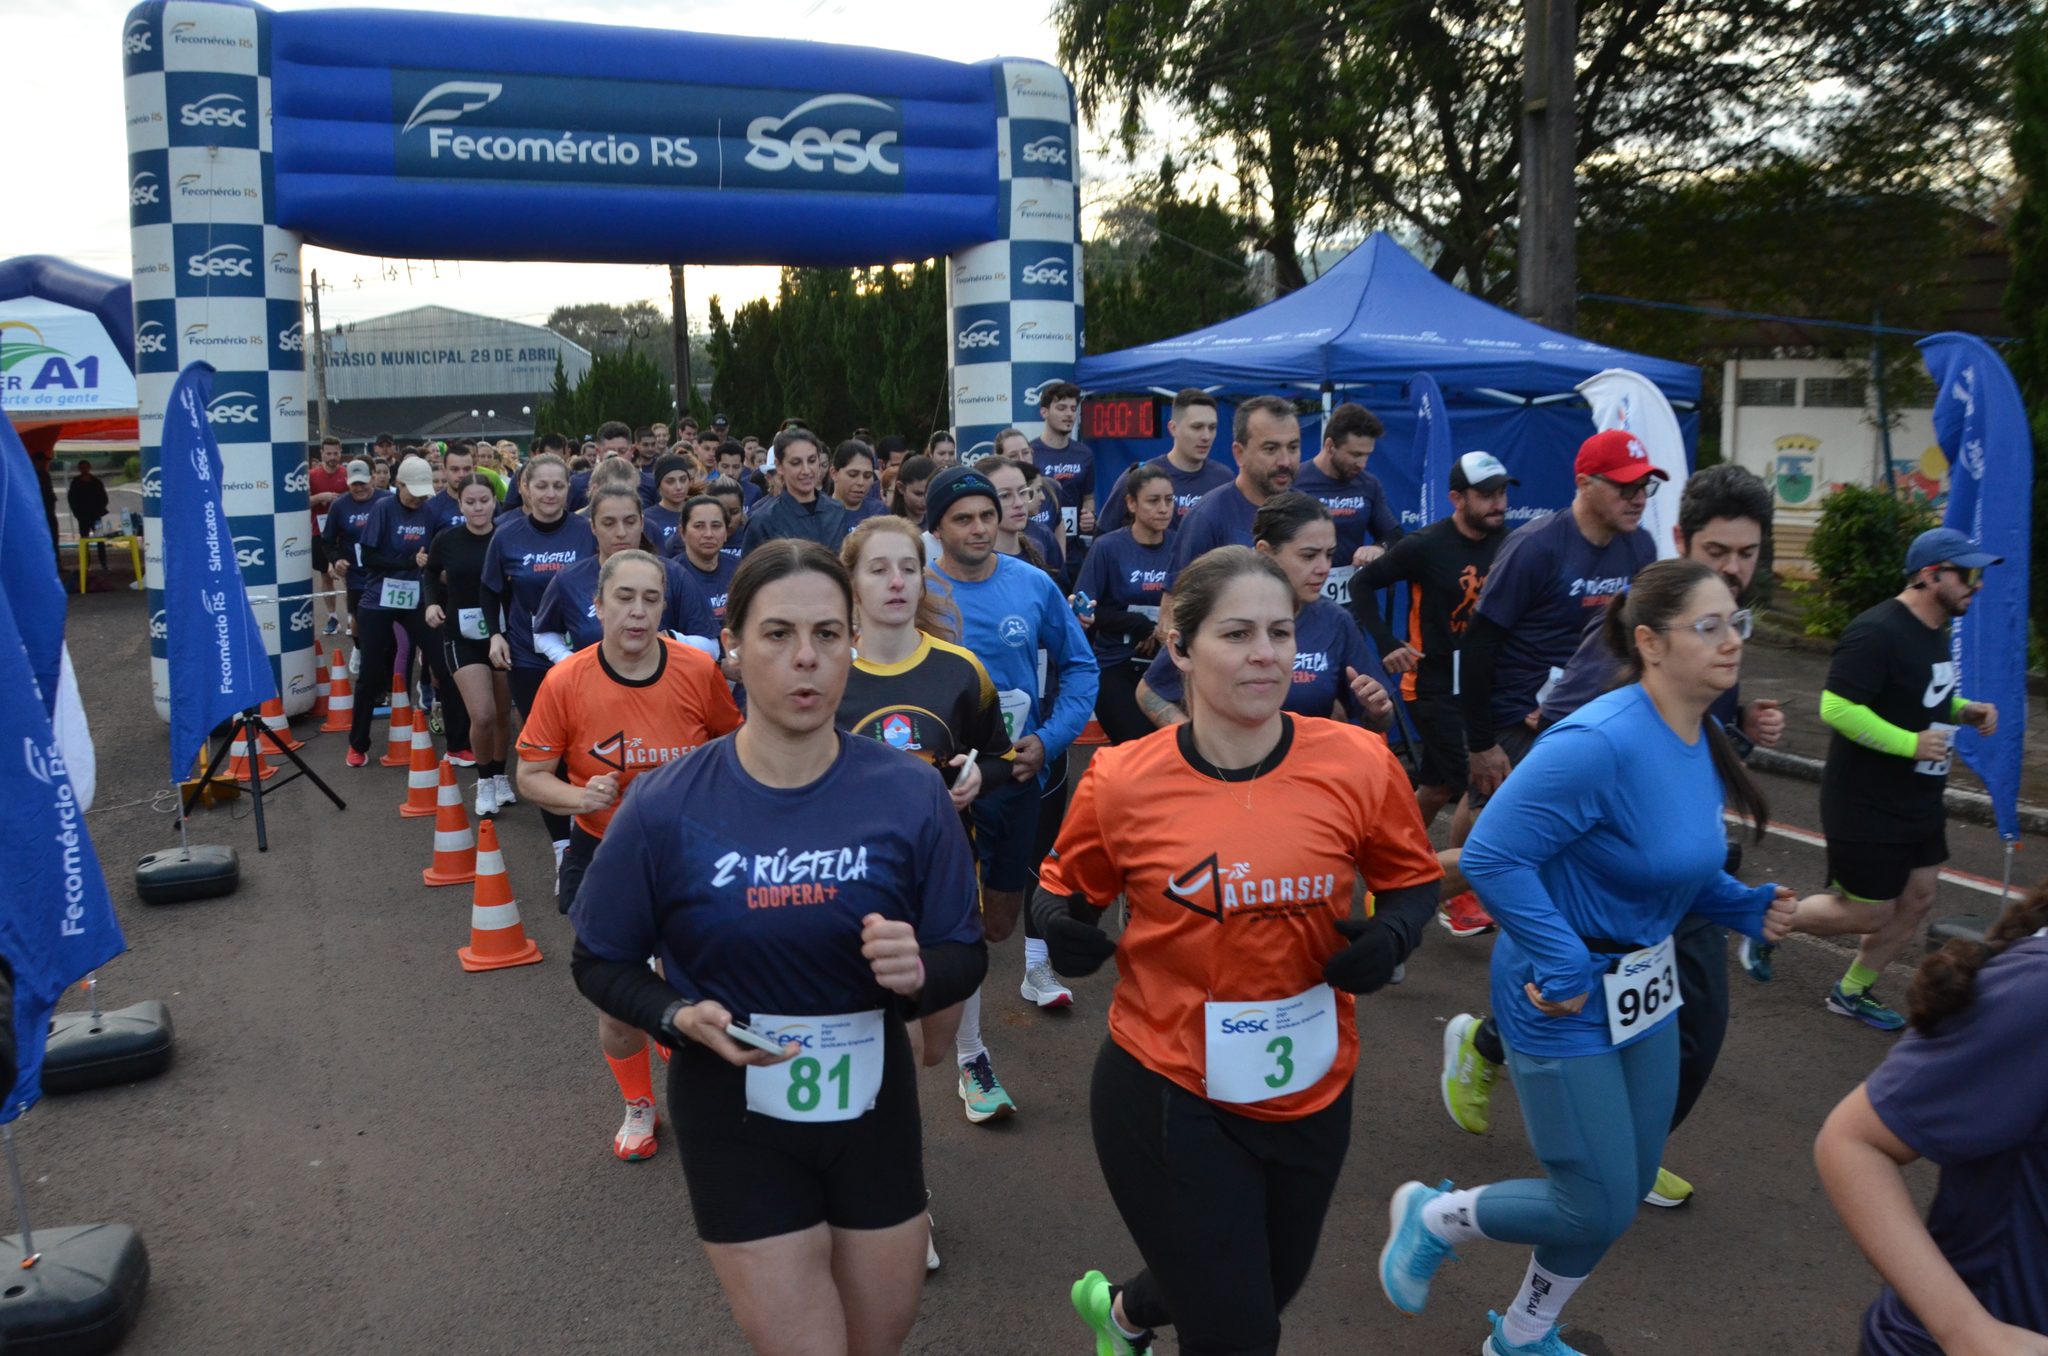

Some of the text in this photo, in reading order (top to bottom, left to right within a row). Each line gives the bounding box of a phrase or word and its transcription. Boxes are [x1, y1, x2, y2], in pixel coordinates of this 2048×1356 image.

[123, 32, 152, 54] esc
[175, 34, 253, 49] Fecomércio RS
[180, 103, 247, 128] Sesc
[429, 126, 698, 168] Fecomércio RS
[744, 116, 900, 175] Sesc
[1022, 142, 1067, 166] Sesc
[181, 186, 258, 198] Fecomércio RS
[158, 262, 170, 273] RS
[187, 254, 253, 277] Sesc
[1021, 264, 1068, 286] Sesc
[189, 335, 263, 345] Fecomércio RS
[278, 330, 304, 352] Ses
[958, 329, 1000, 349] Sesc
[1020, 331, 1064, 341] Fecomércio
[381, 350, 466, 366] MUNICIPAL
[470, 349, 490, 364] 29
[494, 348, 513, 363] DE
[518, 347, 557, 362] ABRIL
[30, 355, 99, 390] A1
[222, 480, 269, 492] mércio RS
[235, 547, 265, 567] sc
[536, 550, 577, 564] RÚSTICA
[197, 446, 234, 694] Fecomércio RS Sindicatos Sesc
[387, 590, 415, 607] 151
[263, 621, 276, 631] RS
[1292, 651, 1329, 672] STICA
[55, 782, 86, 937] Fecomércio
[754, 845, 869, 887] RÚSTICA
[746, 880, 839, 910] COOPERA+
[1617, 964, 1674, 1027] 963
[1221, 1018, 1270, 1034] Sesc
[1264, 1035, 1295, 1089] 3
[787, 1053, 851, 1113] 81
[1526, 1290, 1544, 1317] WEAR
